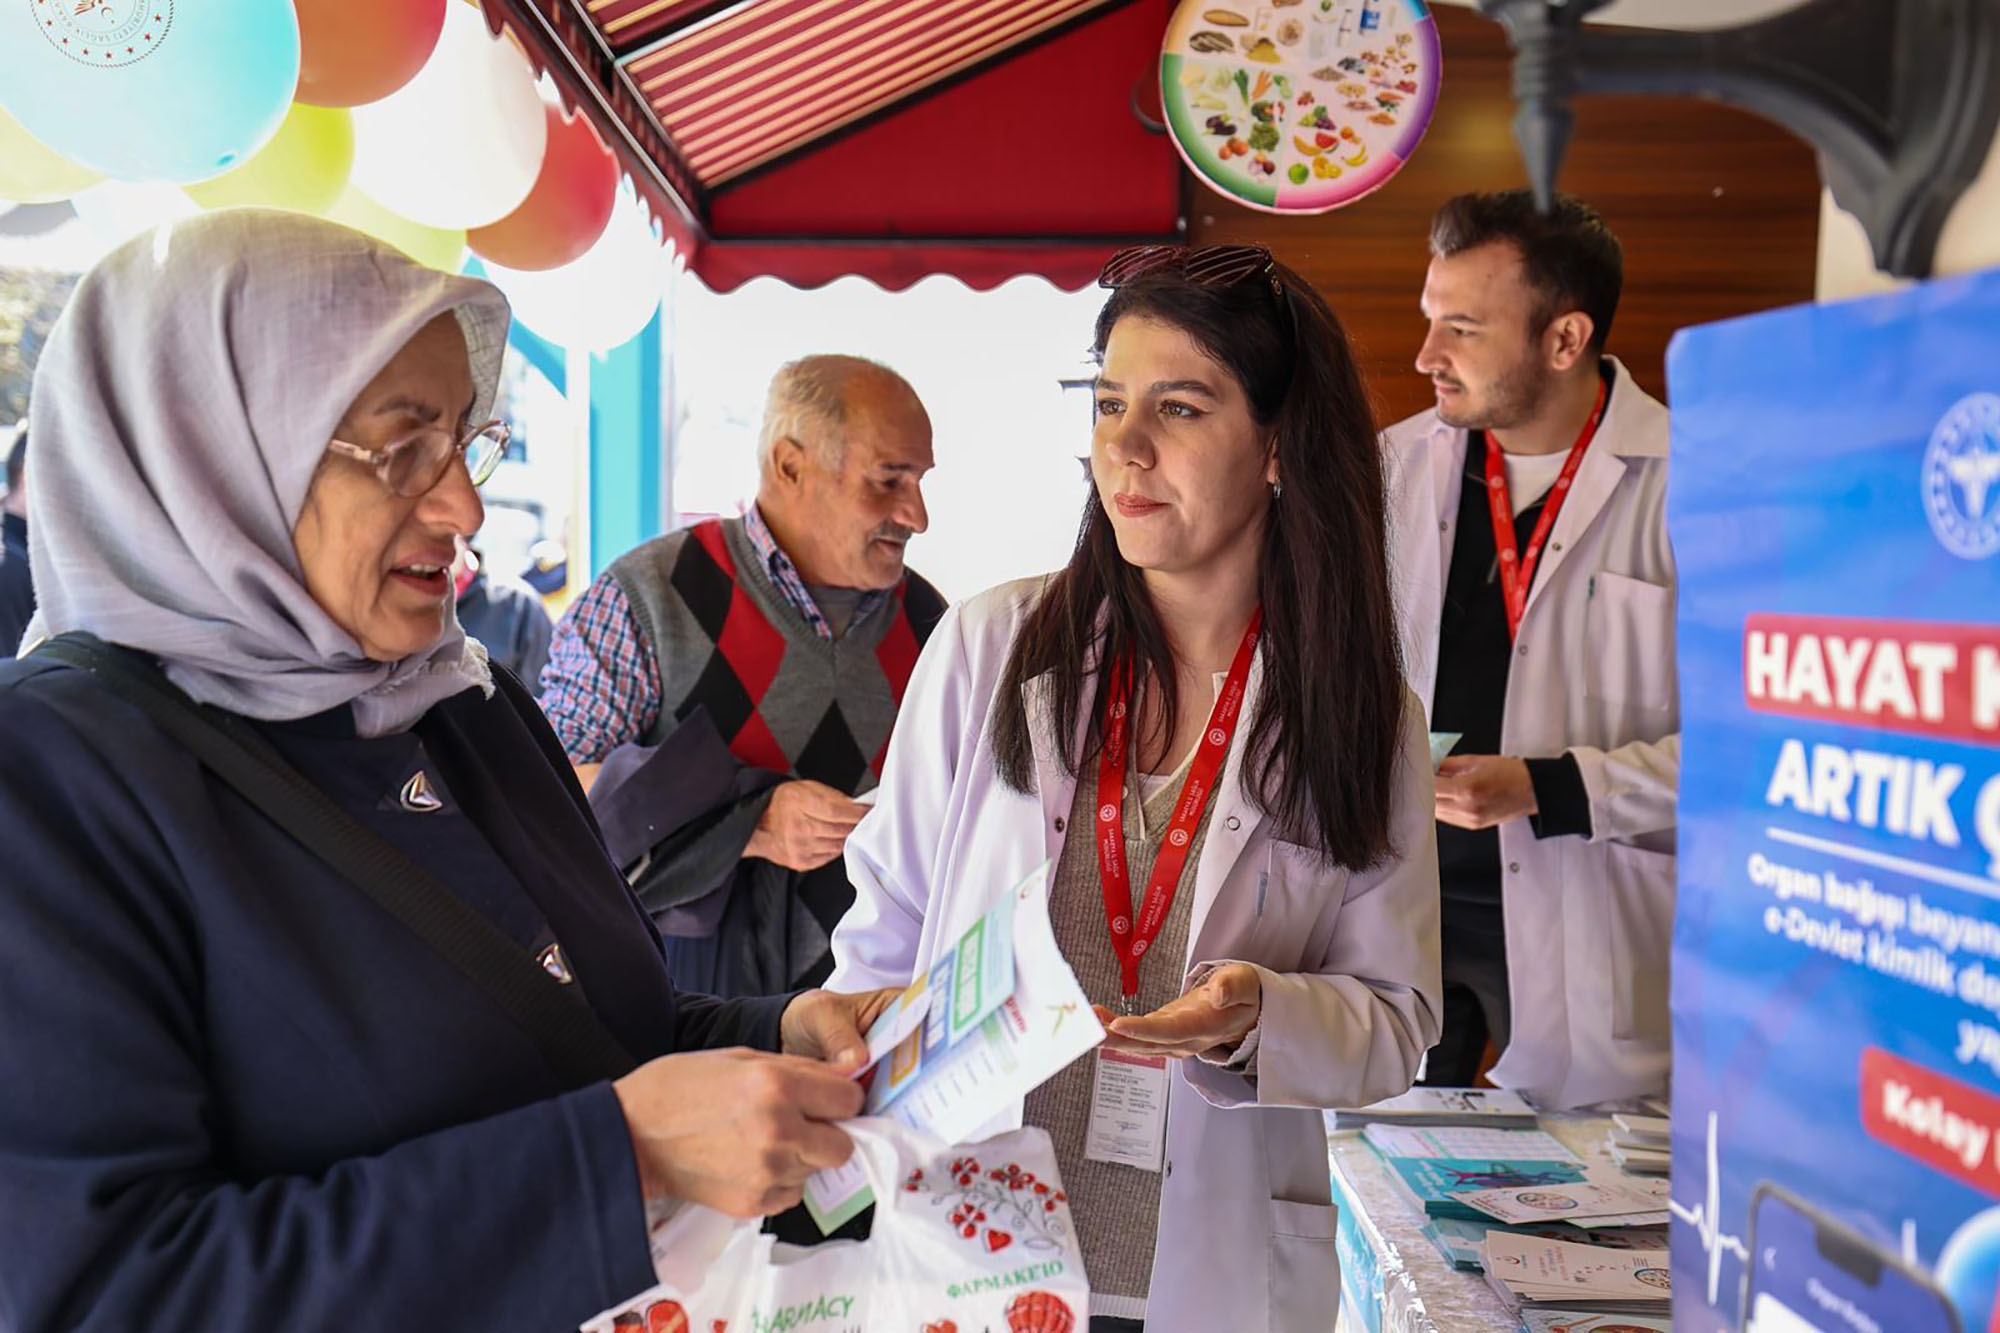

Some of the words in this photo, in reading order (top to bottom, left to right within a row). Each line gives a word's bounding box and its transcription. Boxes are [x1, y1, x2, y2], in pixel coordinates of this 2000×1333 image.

[1748, 631, 1957, 721] HAYAT
[1766, 738, 1965, 847] ARTIK
[1747, 852, 1822, 900] Organ
[1764, 906, 1864, 962] e-Devlet
[1866, 930, 1955, 997] kimlik
[1884, 1080, 1990, 1171] Kolay
